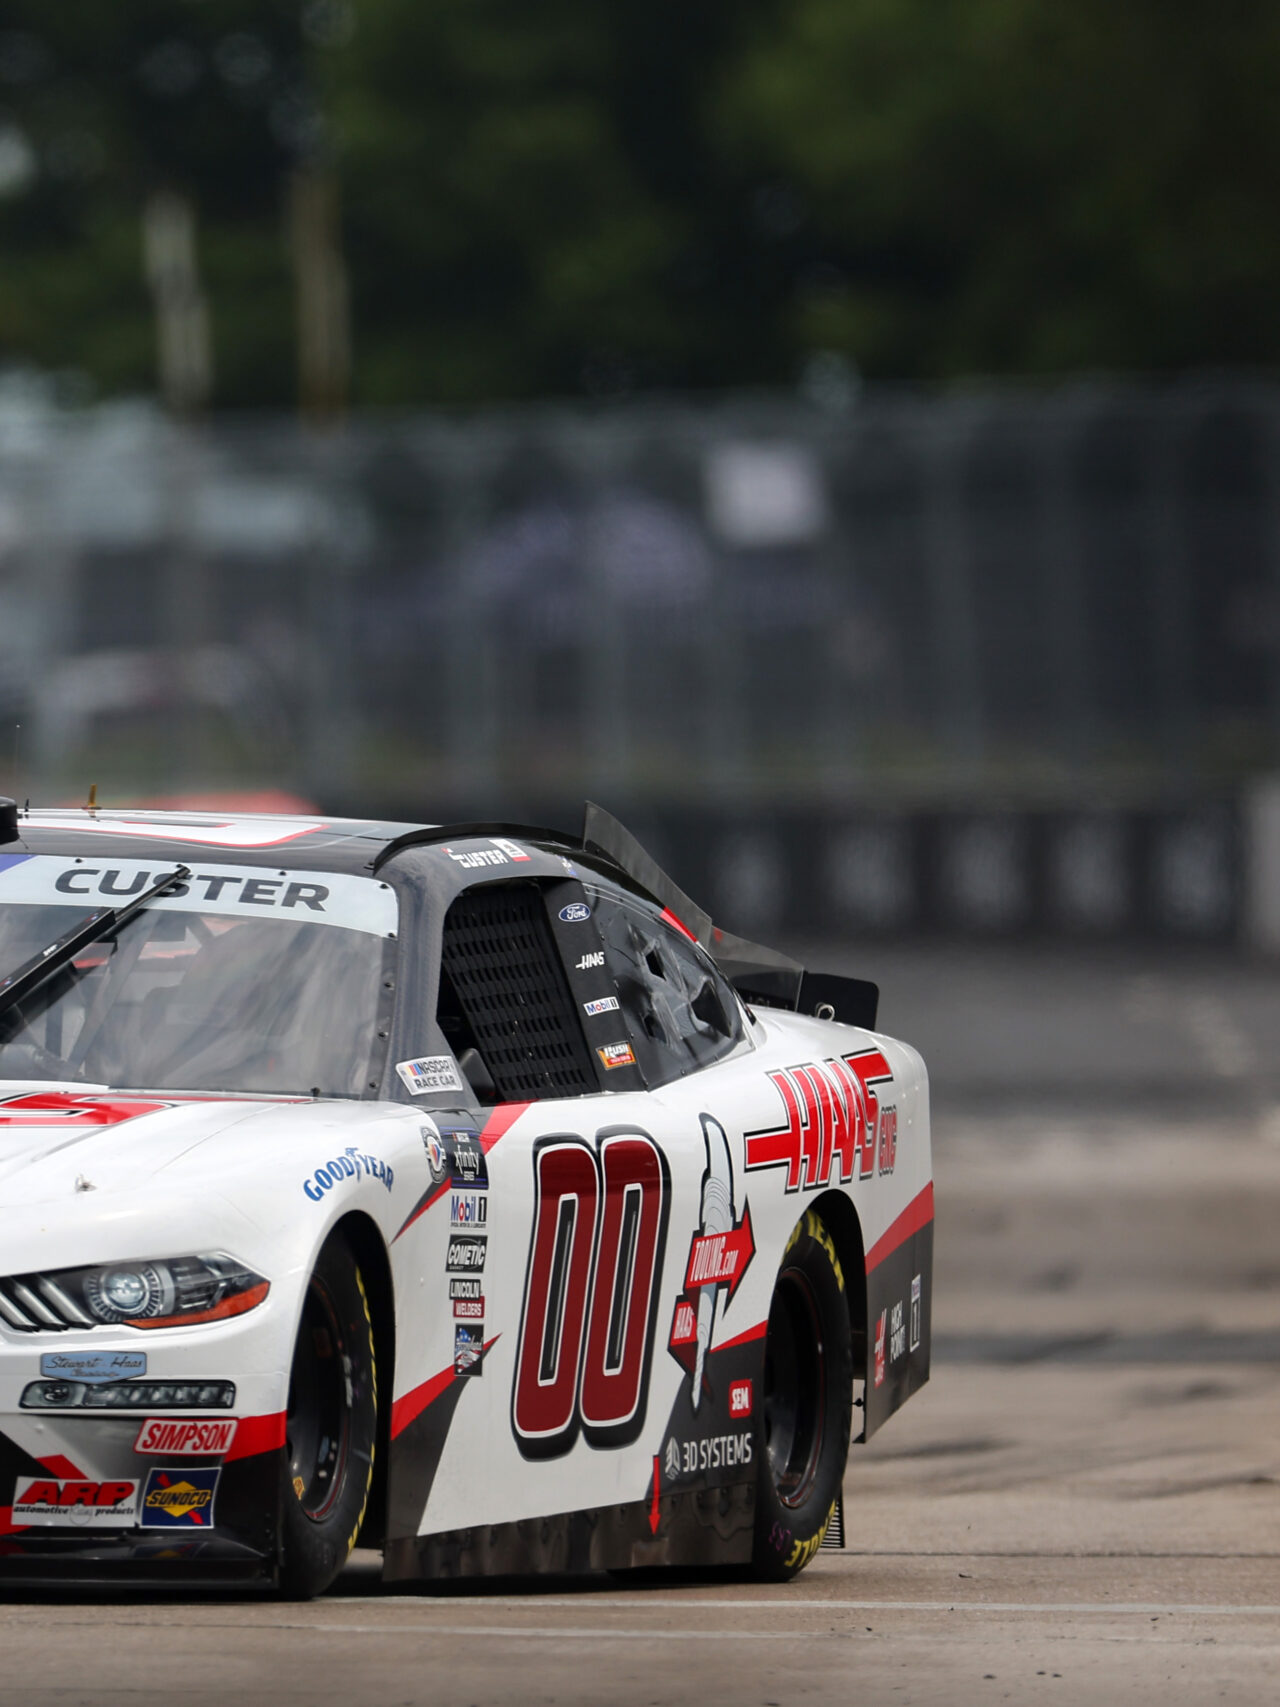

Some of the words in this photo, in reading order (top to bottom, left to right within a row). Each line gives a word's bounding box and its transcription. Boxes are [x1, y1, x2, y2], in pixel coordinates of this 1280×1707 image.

[454, 849, 509, 869] CUSTER
[55, 868, 331, 912] CUSTER
[566, 905, 588, 920] Ford
[575, 952, 606, 970] HAAS
[586, 1000, 610, 1016] Mobil
[417, 1060, 451, 1075] NASCAR
[414, 1077, 440, 1089] RACE
[440, 1075, 457, 1087] CAR
[743, 1047, 894, 1195] HAAS
[454, 1144, 480, 1176] xfinity
[451, 1195, 476, 1222] Mobil
[448, 1244, 486, 1267] COMETIC
[451, 1281, 481, 1299] LINCOLN
[512, 1126, 671, 1460] 00
[456, 1302, 483, 1317] WELDERS
[732, 1387, 750, 1411] SEM
[141, 1422, 234, 1451] SIMPSON
[682, 1441, 698, 1473] 3D
[700, 1432, 753, 1470] SYSTEMS
[15, 1480, 136, 1507] ARP
[146, 1489, 212, 1507] SUNOCO
[13, 1504, 70, 1515] automotive
[94, 1506, 135, 1518] products
